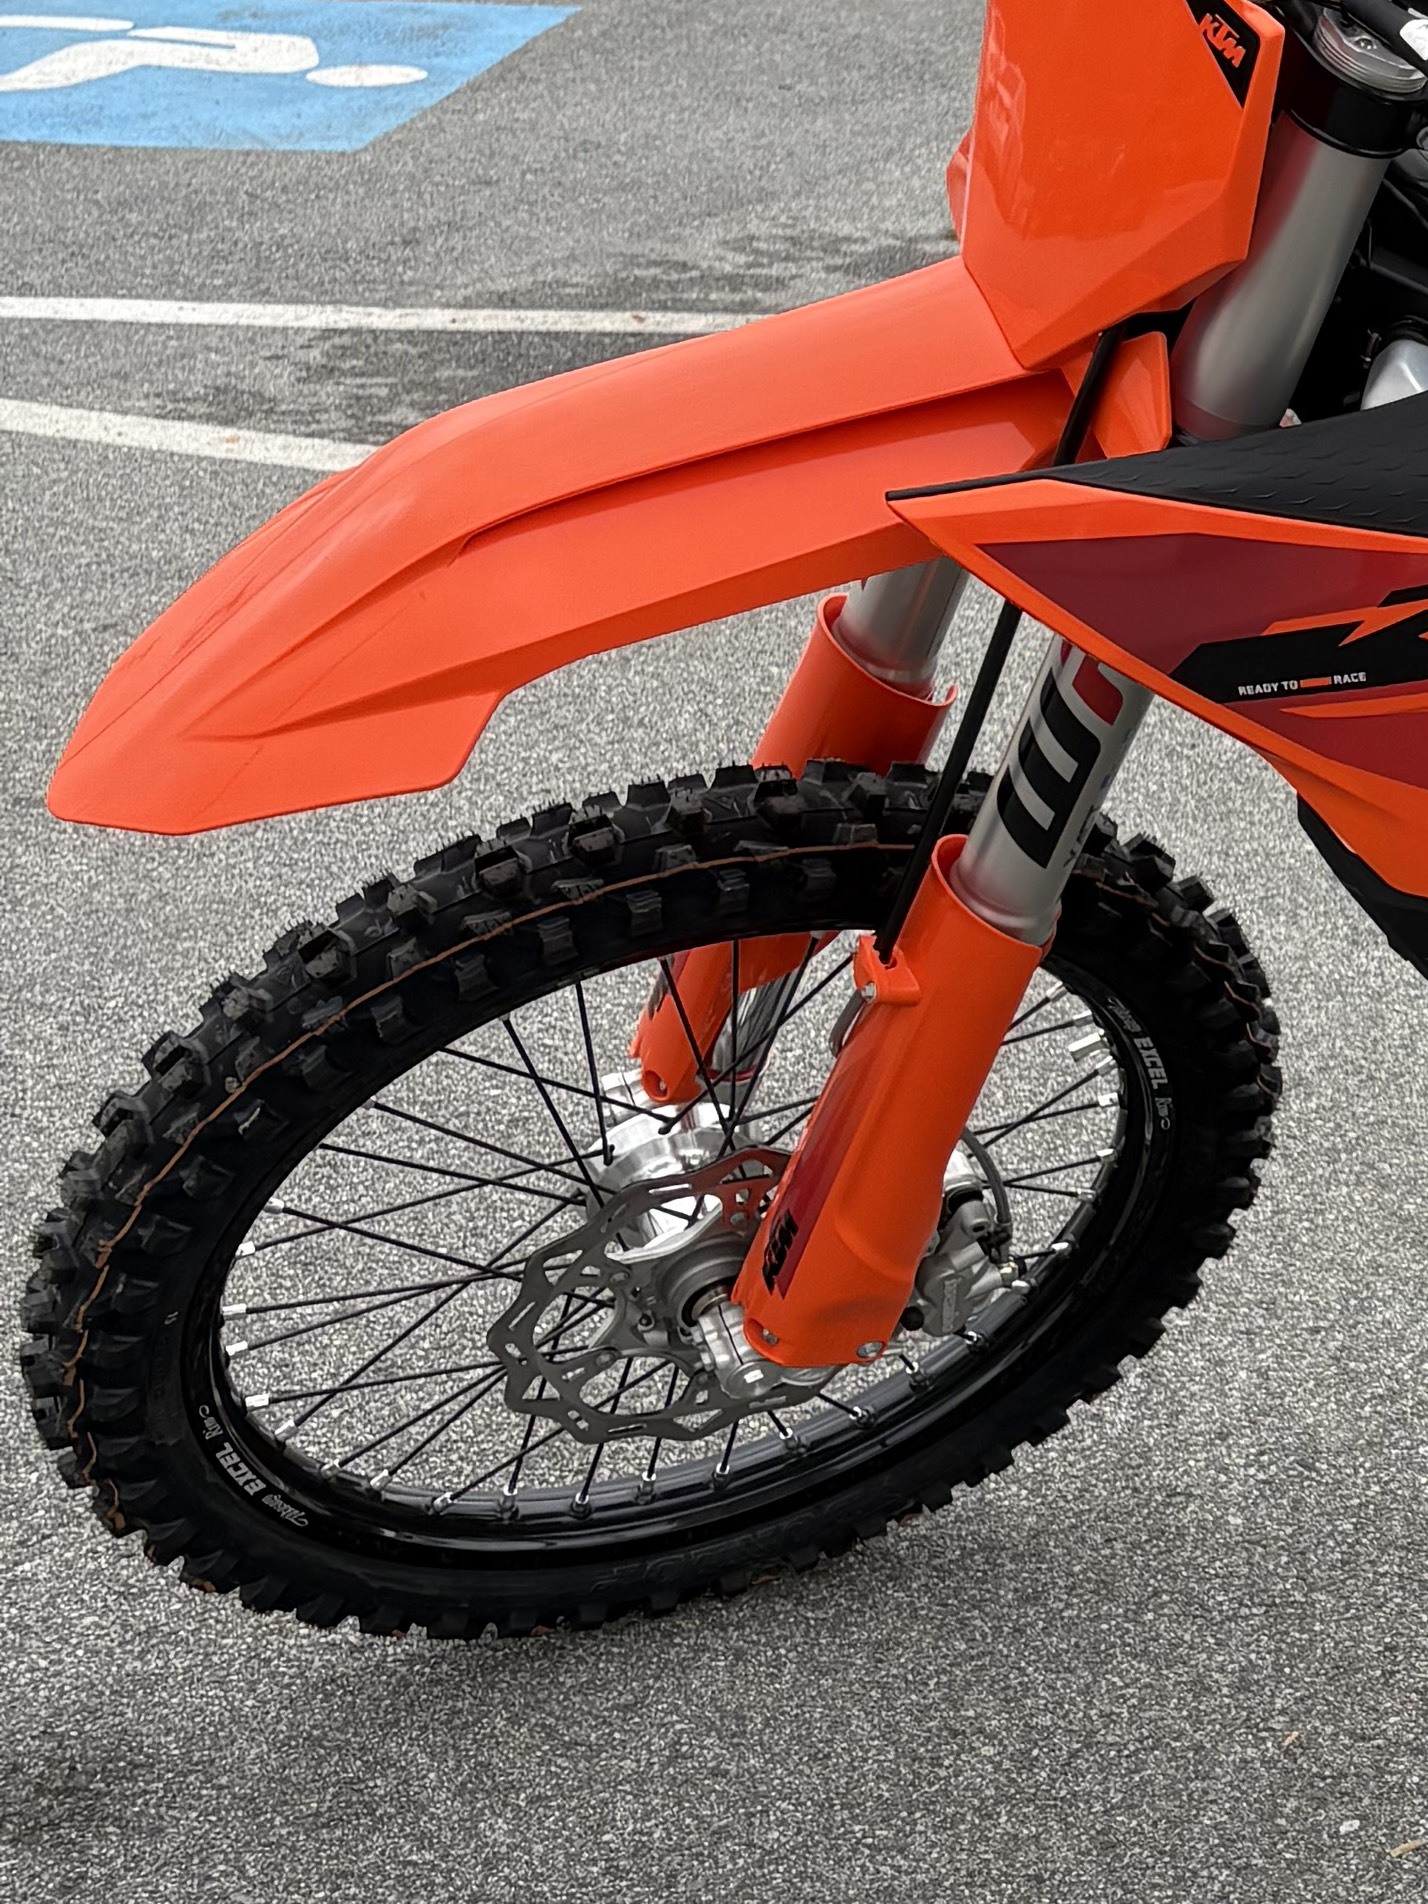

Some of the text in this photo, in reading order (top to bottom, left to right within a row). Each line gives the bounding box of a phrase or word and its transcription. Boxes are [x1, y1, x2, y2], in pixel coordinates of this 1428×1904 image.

[1199, 12, 1246, 68] KTM
[1238, 672, 1367, 696] READY TO RACE
[1133, 1036, 1168, 1090] EXCEL
[215, 1441, 267, 1497] EXCEL
